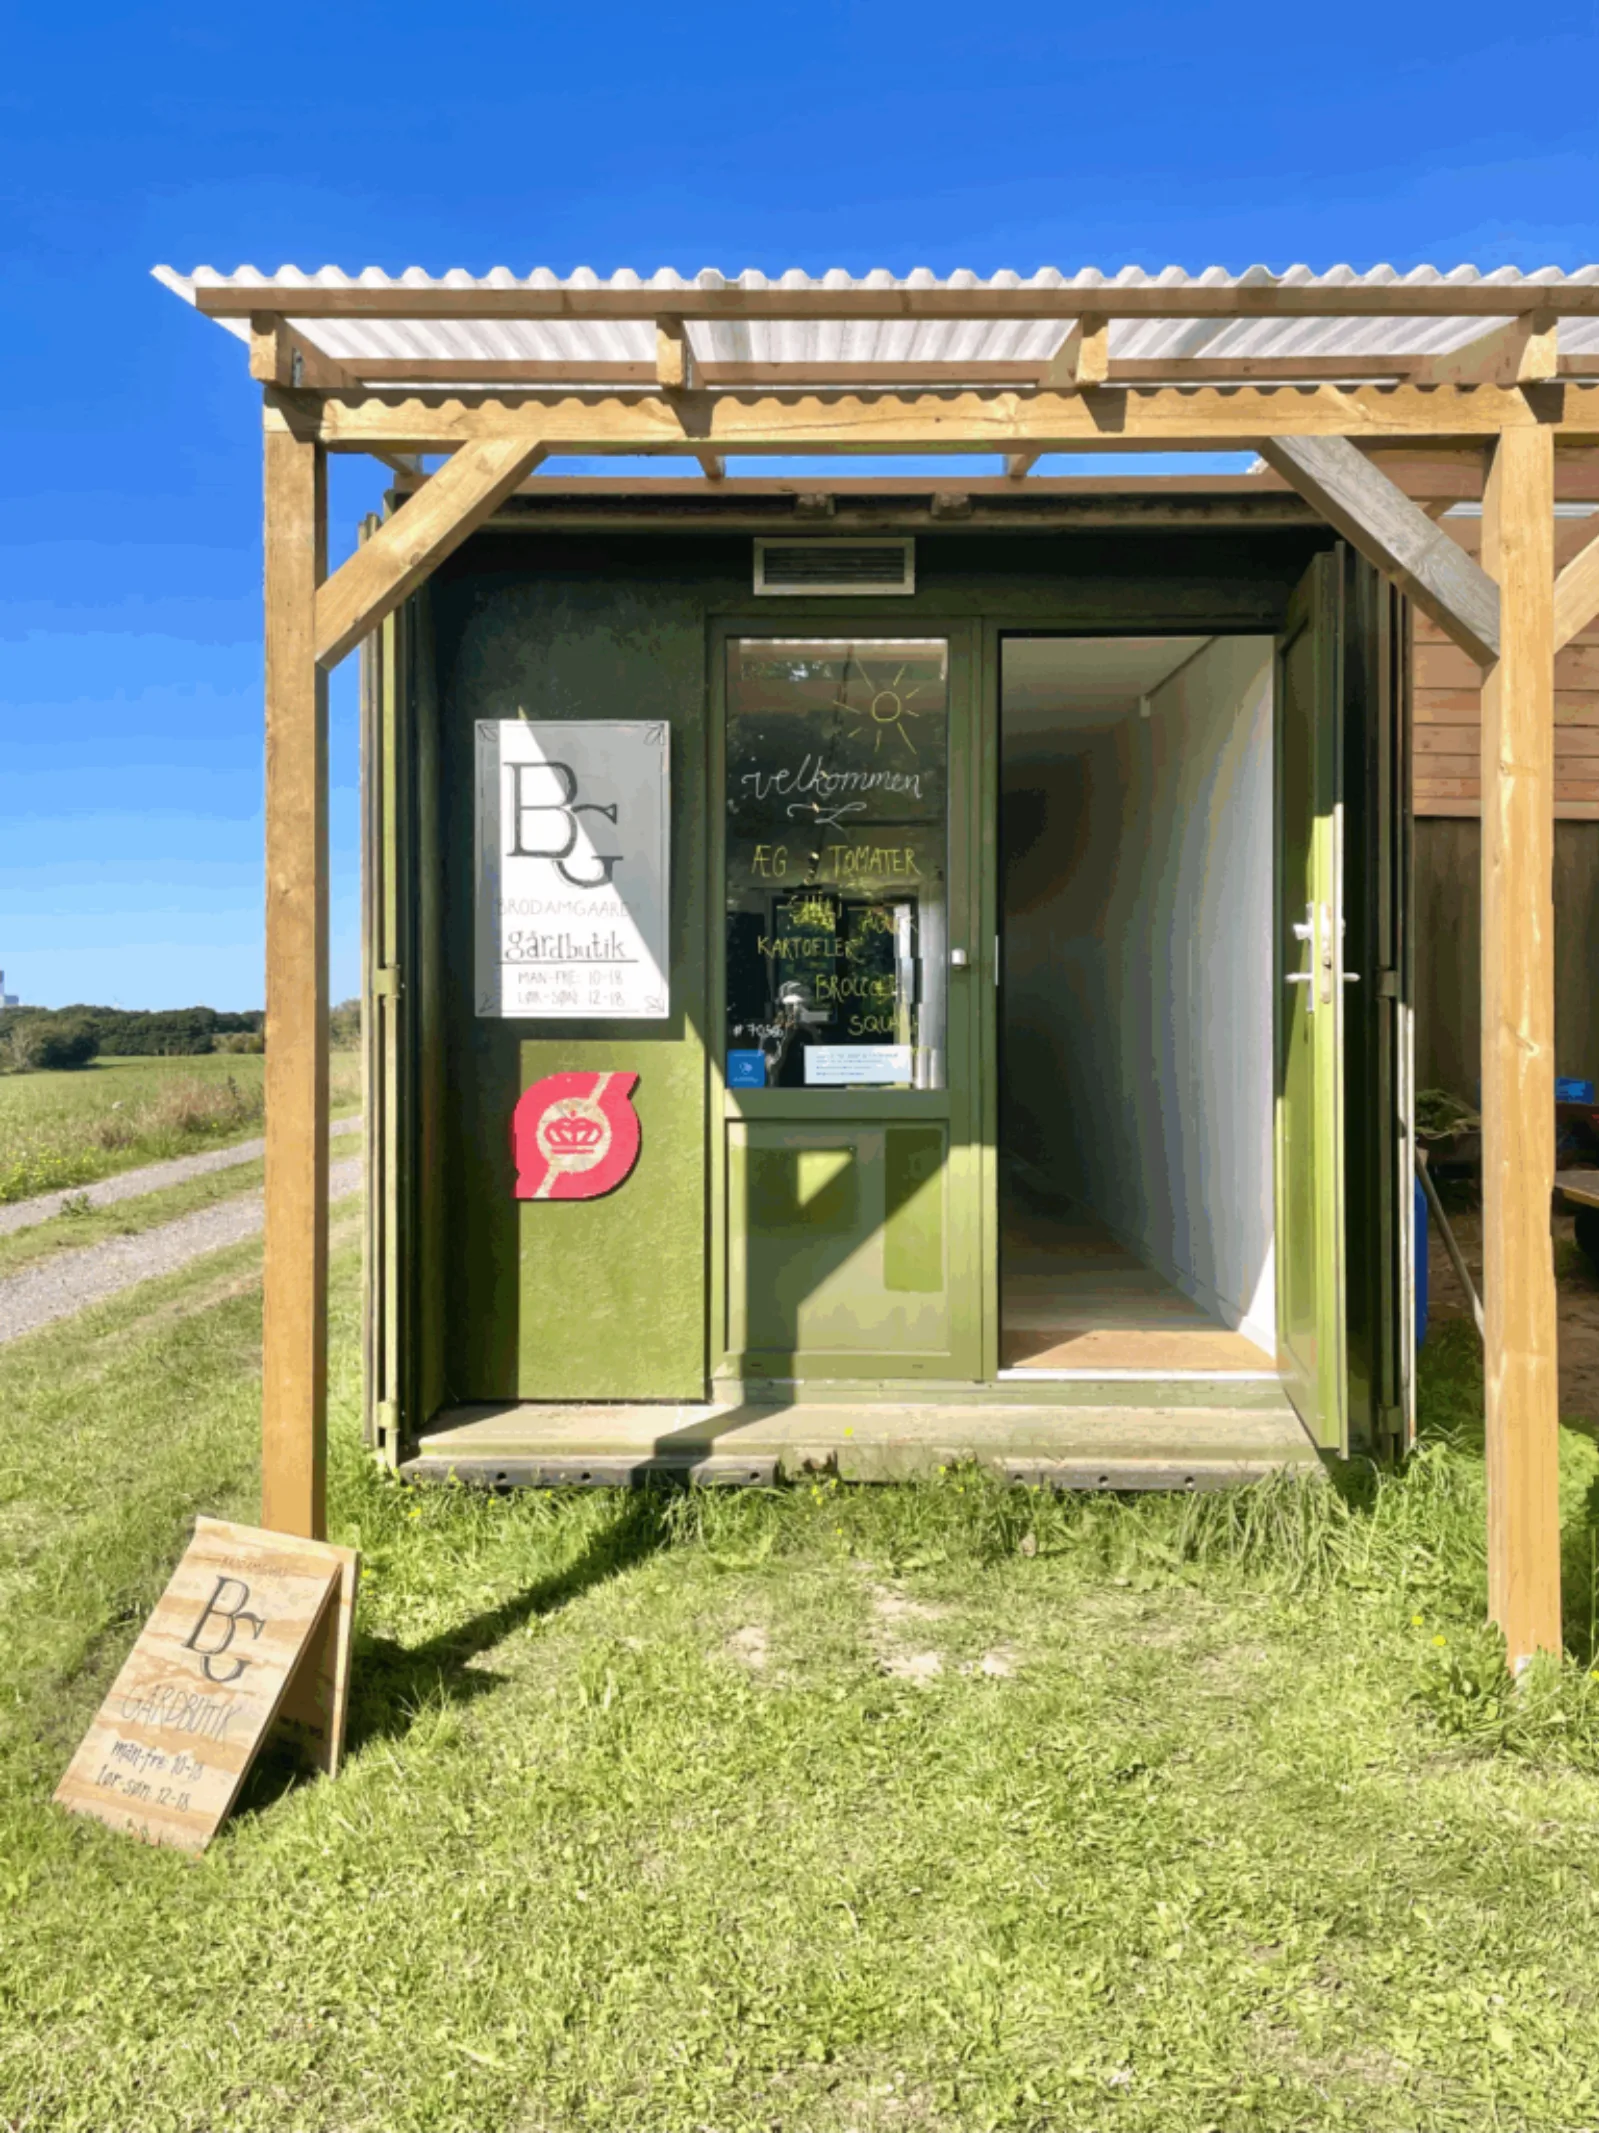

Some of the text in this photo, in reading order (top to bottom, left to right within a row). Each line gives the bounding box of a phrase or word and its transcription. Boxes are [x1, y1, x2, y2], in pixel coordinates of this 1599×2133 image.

[741, 753, 923, 800] velkommen
[502, 761, 624, 889] BG
[751, 845, 921, 877] ÆG TOMATER
[504, 929, 626, 961] gårdbutik
